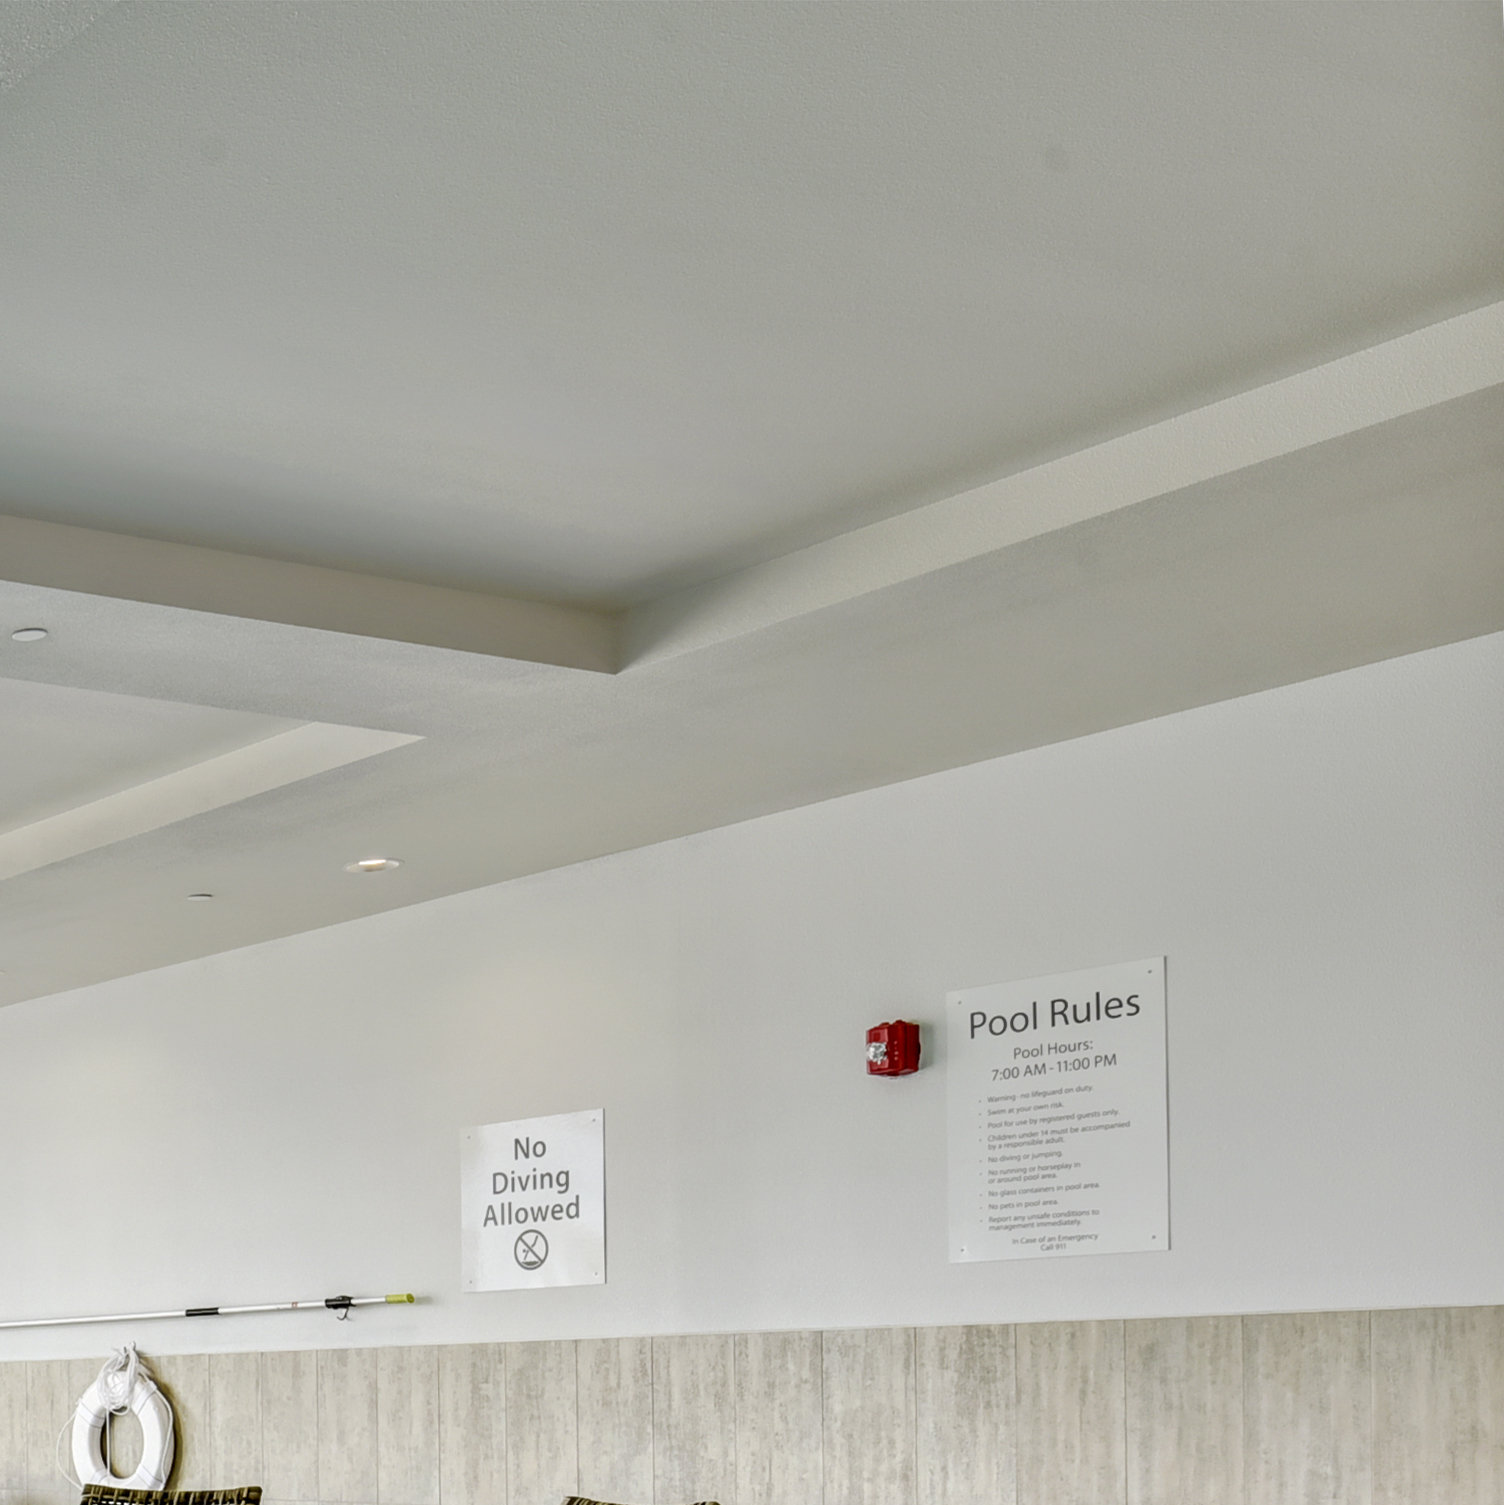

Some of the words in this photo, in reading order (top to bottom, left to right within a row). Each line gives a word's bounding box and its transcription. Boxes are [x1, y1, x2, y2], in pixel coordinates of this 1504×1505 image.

[970, 1001, 1037, 1039] Pool
[1050, 991, 1140, 1027] Rules
[1013, 1043, 1043, 1060] Pool
[1047, 1040, 1093, 1055] Hours:
[992, 1066, 1020, 1081] 7:00
[1023, 1063, 1047, 1077] AM
[1057, 1057, 1090, 1072] 11:00
[1094, 1053, 1117, 1068] PM
[513, 1136, 547, 1160] No
[492, 1168, 569, 1195] Diving
[483, 1194, 580, 1227] Allowed
